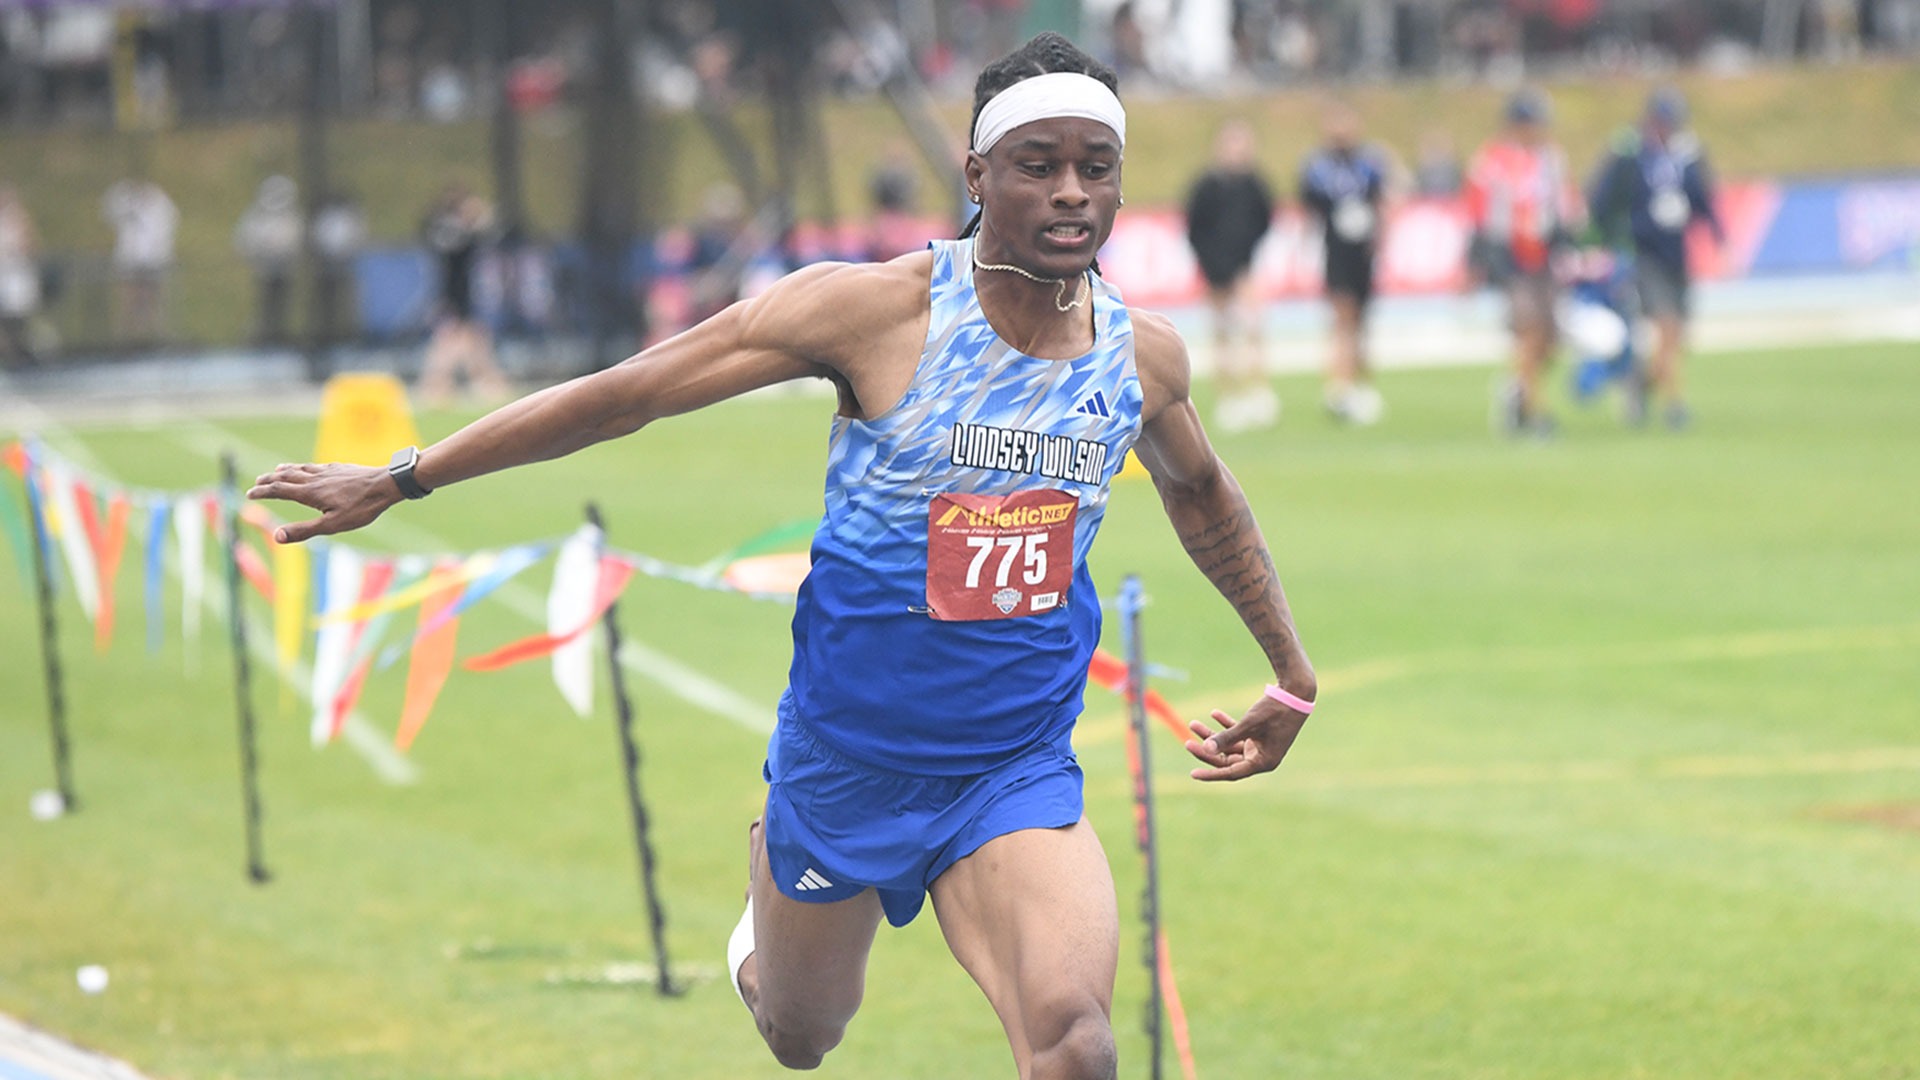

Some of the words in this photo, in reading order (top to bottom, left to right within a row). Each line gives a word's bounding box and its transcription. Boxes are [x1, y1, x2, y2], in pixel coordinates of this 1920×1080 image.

[950, 422, 1039, 475] LINDSEY
[1040, 434, 1107, 487] WILSON
[965, 532, 1049, 588] 775
